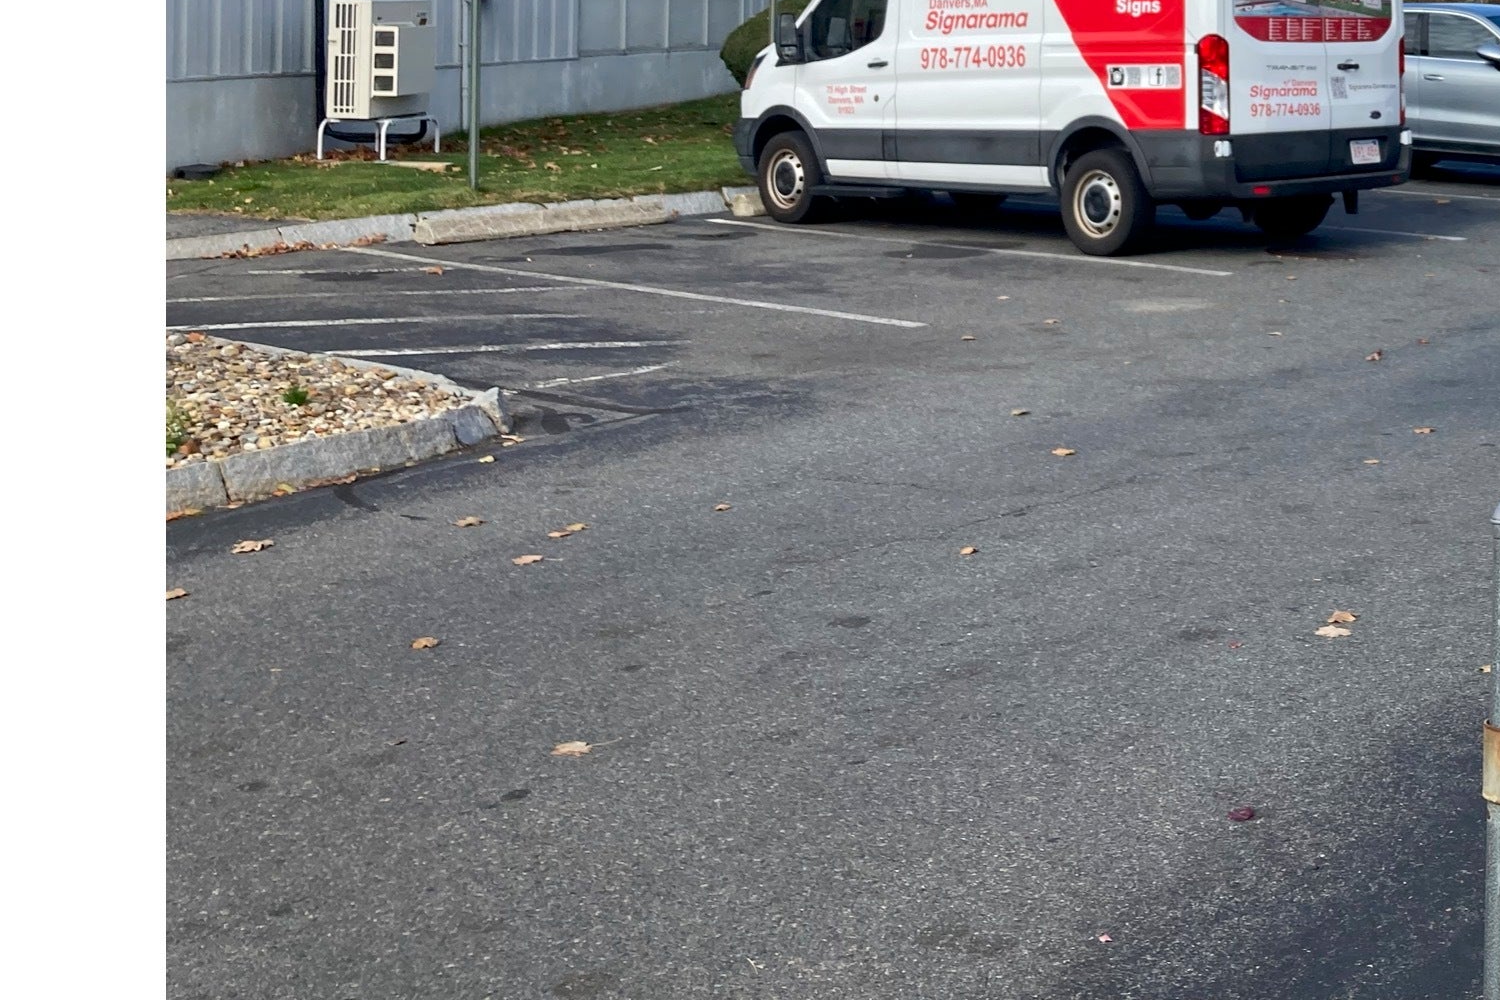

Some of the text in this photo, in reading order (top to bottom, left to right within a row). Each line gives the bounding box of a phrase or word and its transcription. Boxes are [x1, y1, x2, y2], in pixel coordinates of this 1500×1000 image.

[925, 10, 1029, 35] Signarama
[921, 46, 1026, 69] 978-774-0936
[1250, 85, 1317, 100] Signarama
[1250, 103, 1320, 117] 978-774-0936
